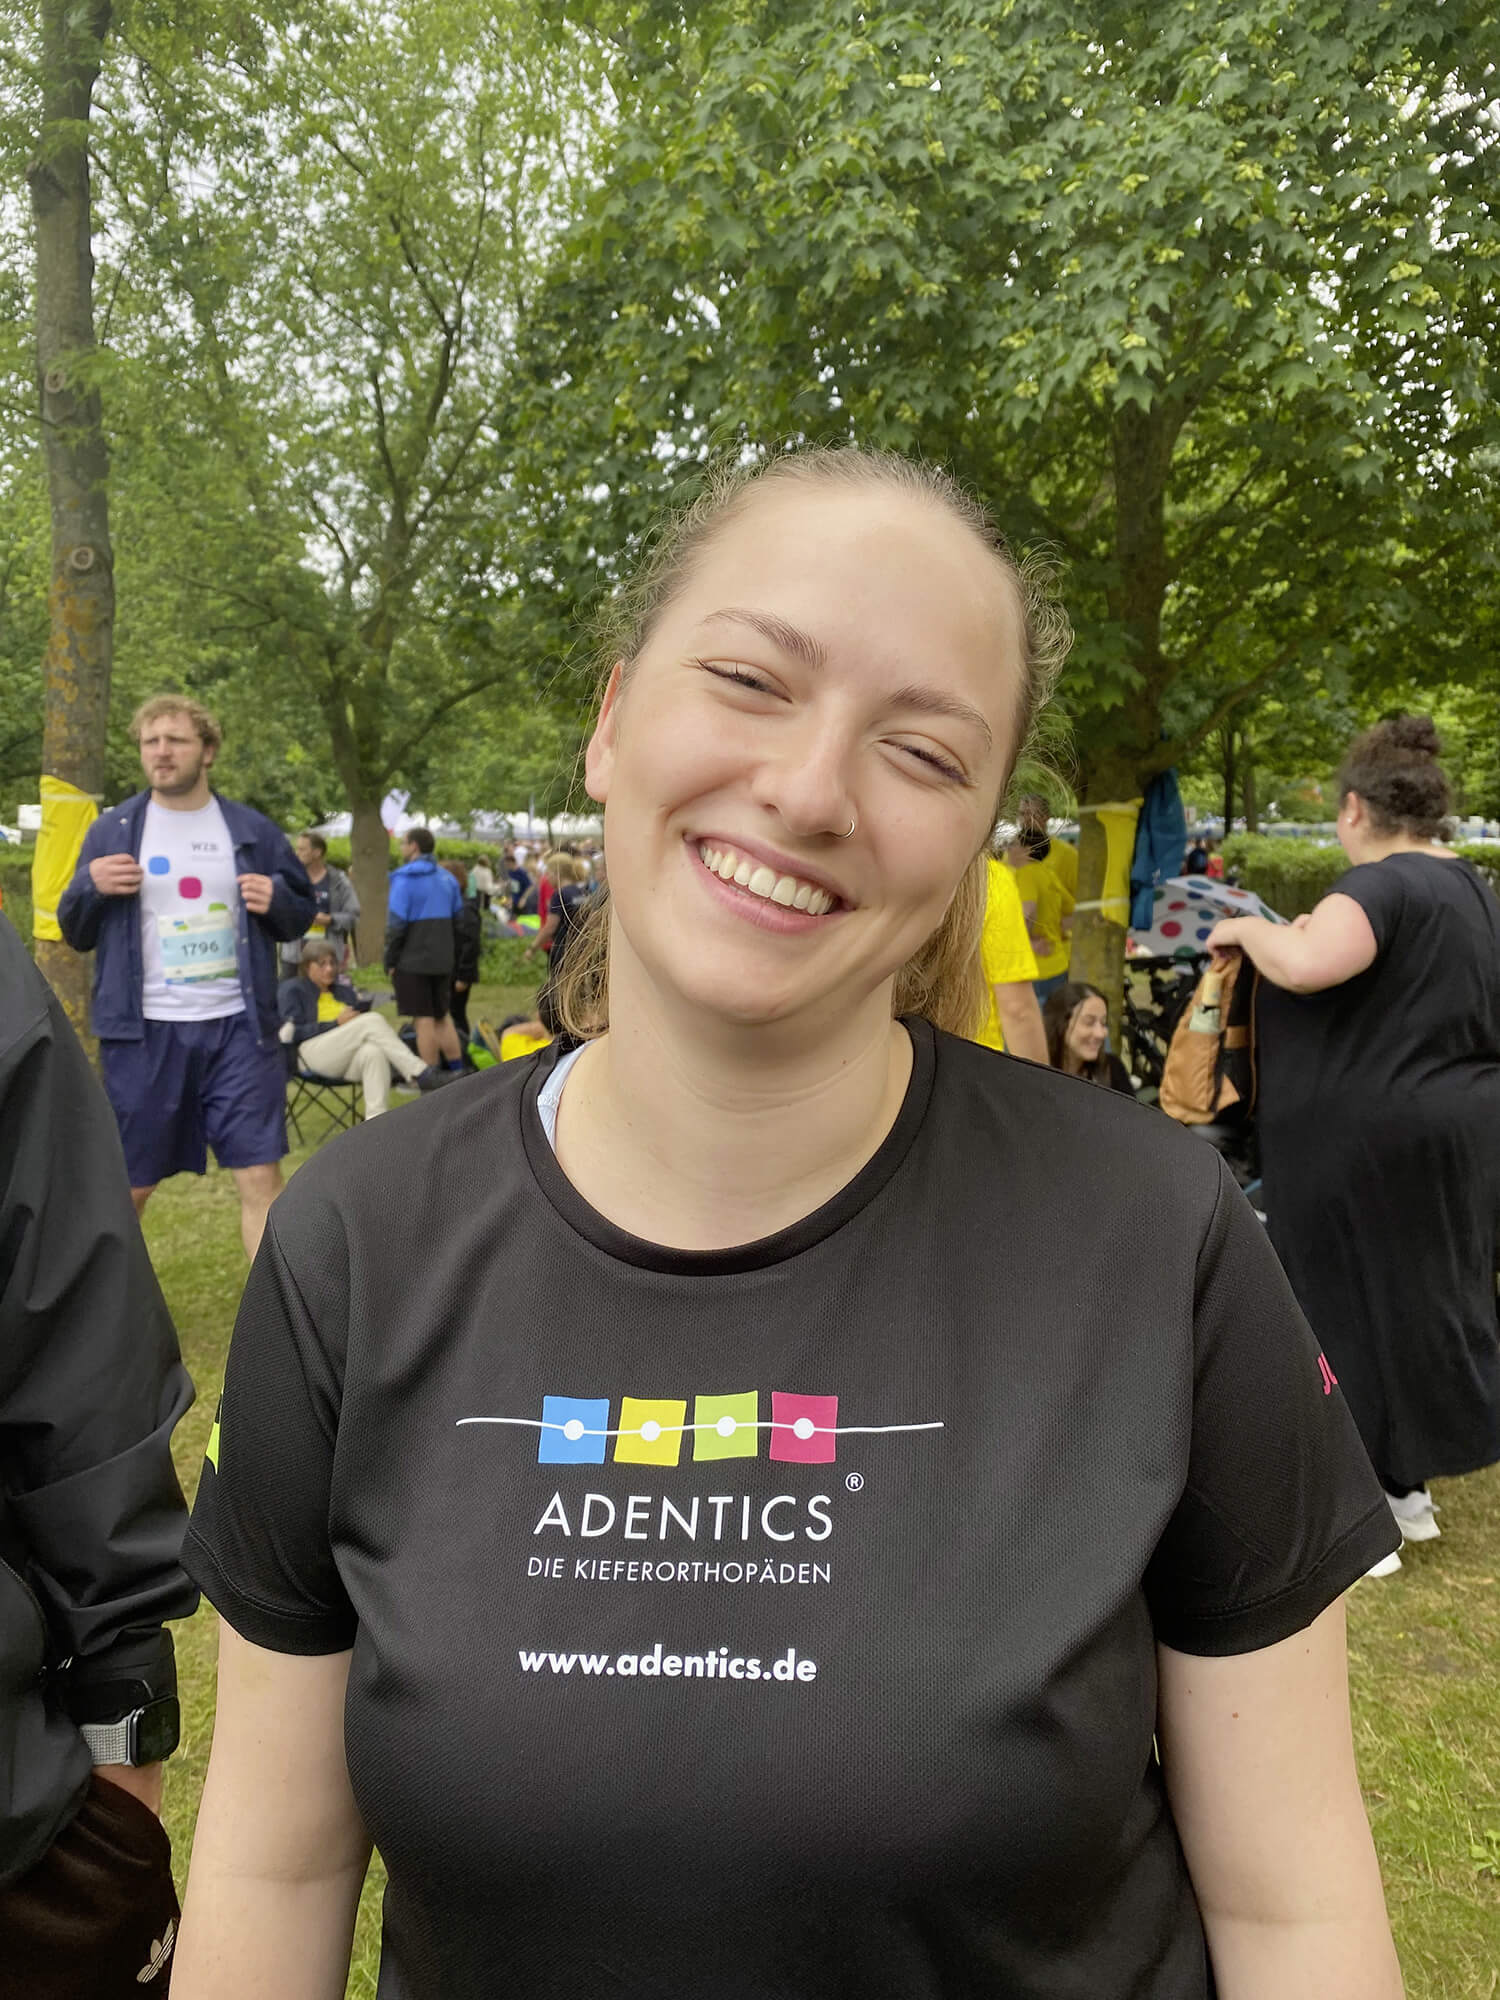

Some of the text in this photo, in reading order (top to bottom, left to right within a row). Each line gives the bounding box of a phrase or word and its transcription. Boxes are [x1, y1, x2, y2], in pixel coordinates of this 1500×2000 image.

[182, 941, 219, 956] 1796
[533, 1490, 833, 1542] ADENTICS
[527, 1556, 831, 1585] DIE KIEFERORTHOPÄDEN
[518, 1643, 817, 1682] www.adentics.de
